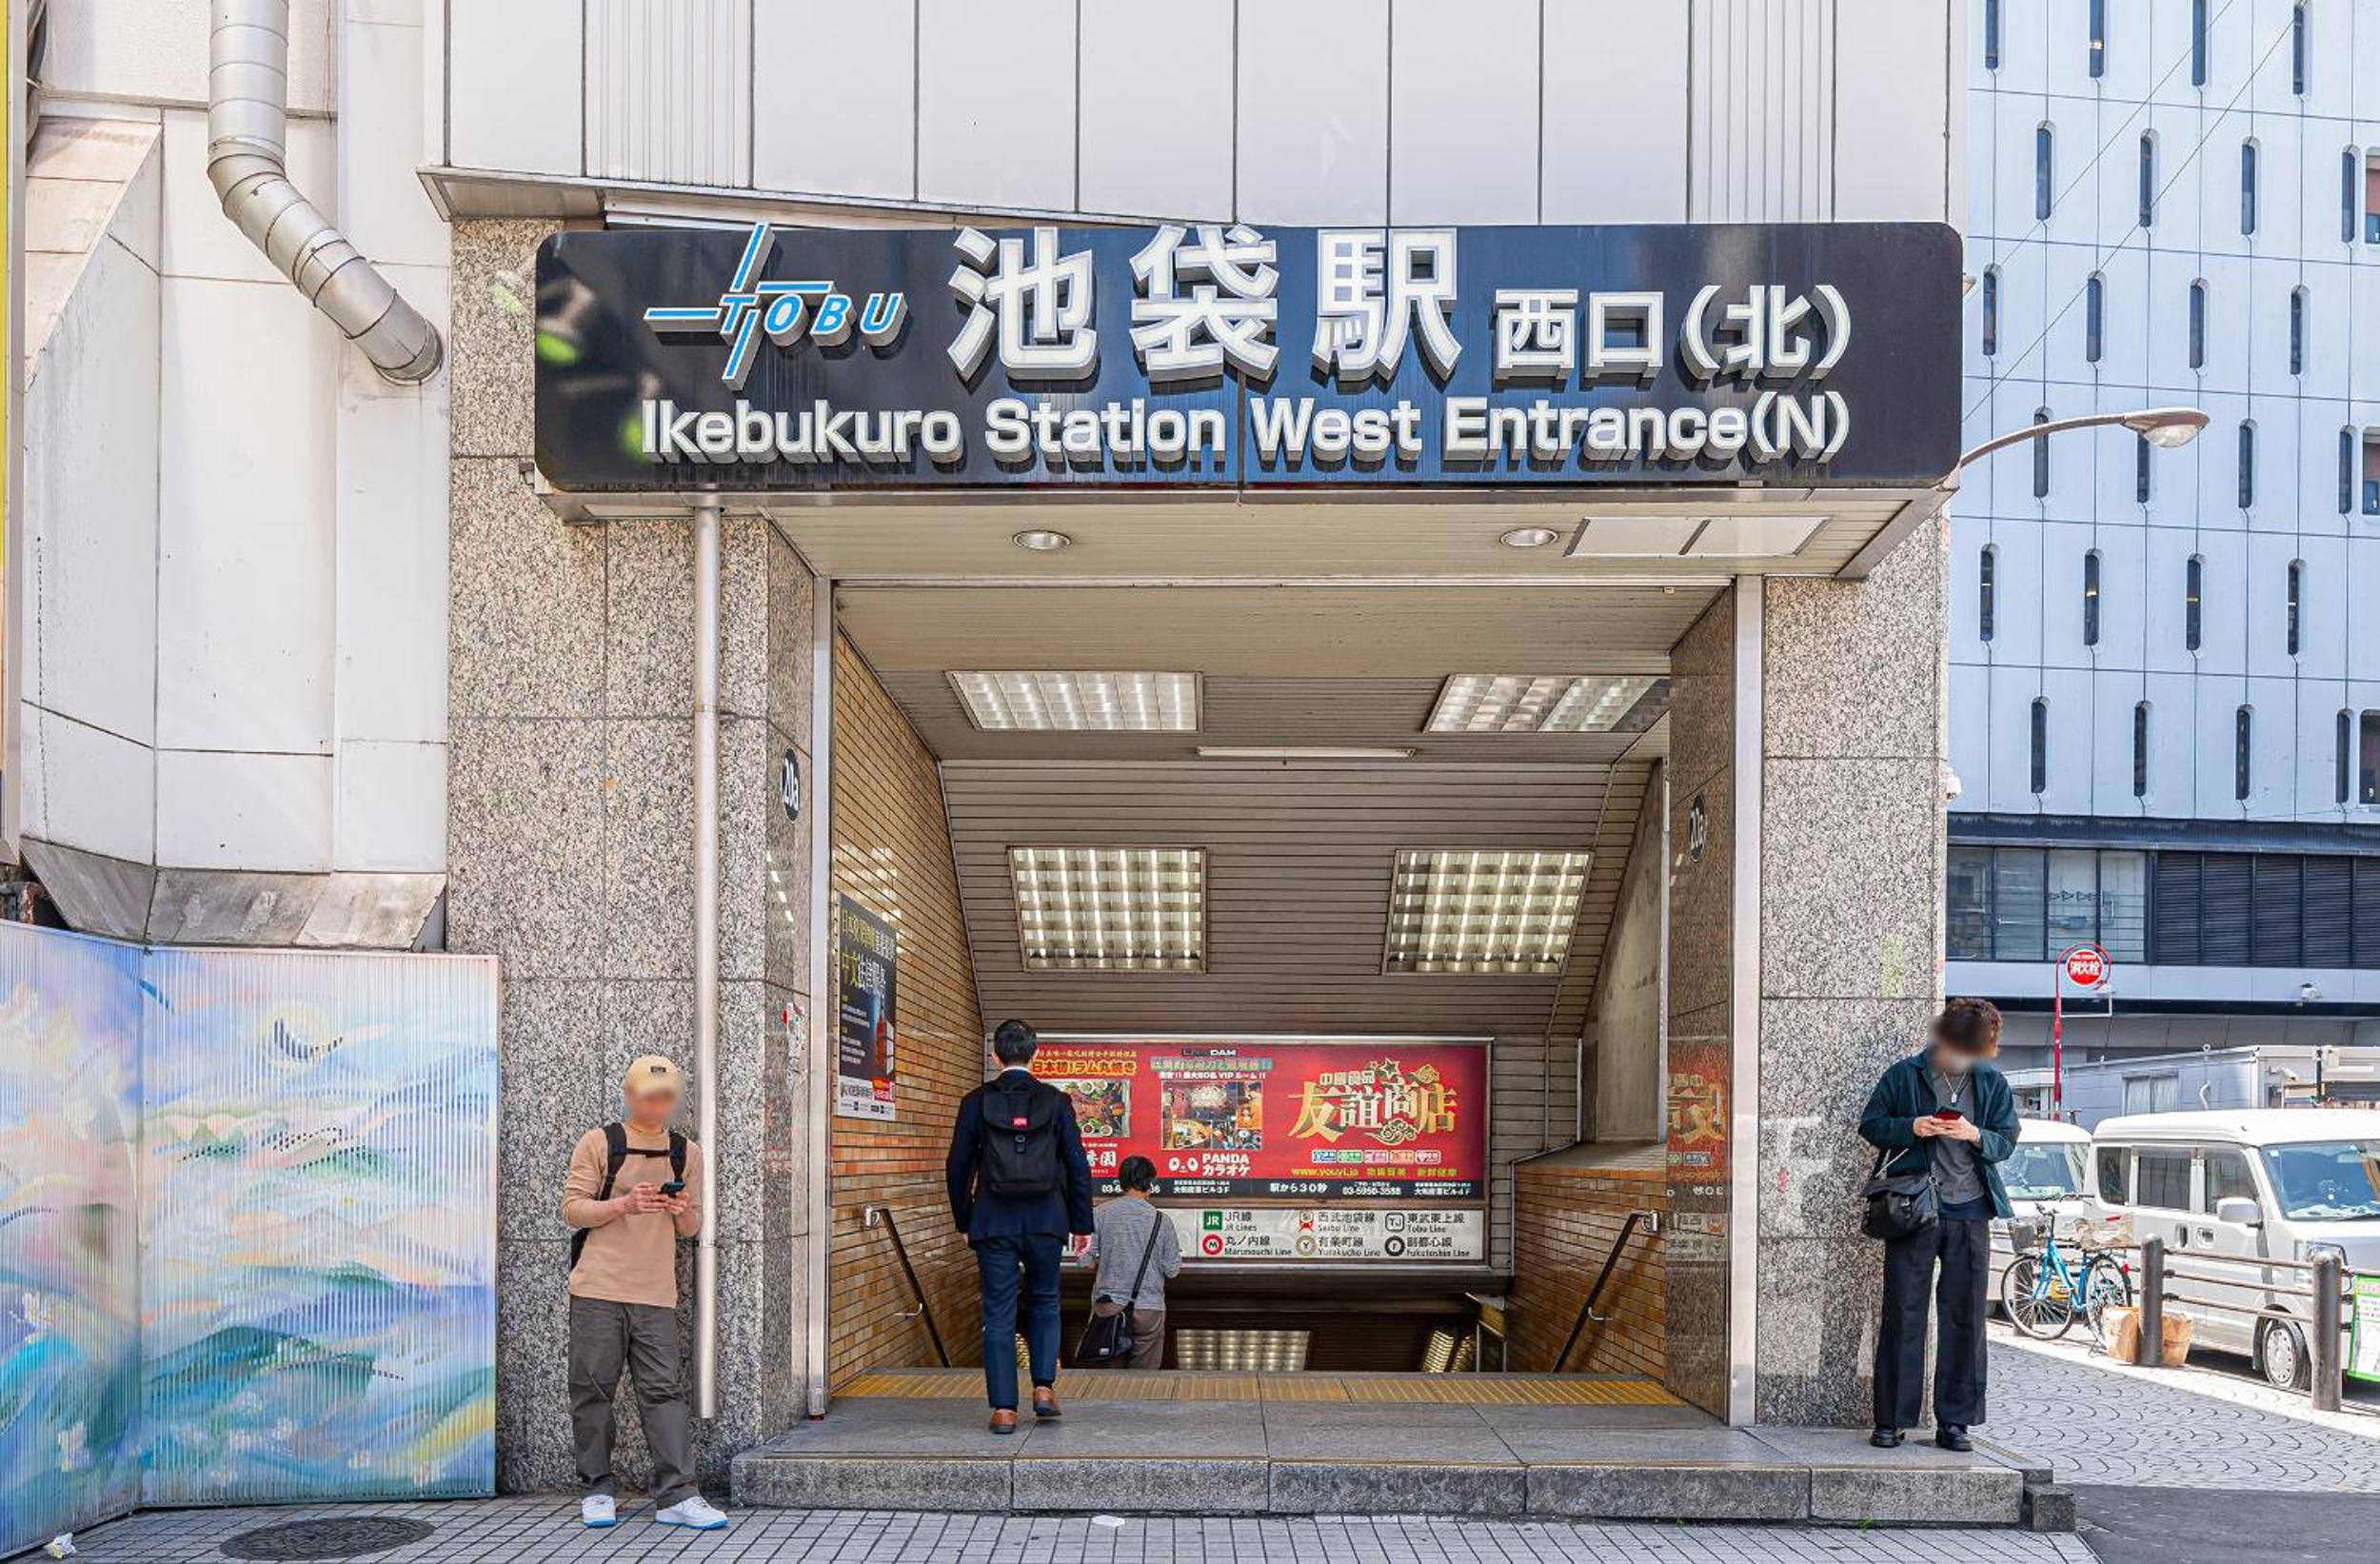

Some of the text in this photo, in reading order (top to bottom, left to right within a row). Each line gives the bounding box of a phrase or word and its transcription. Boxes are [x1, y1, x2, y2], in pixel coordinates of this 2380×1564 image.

[720, 292, 905, 339] TOBU
[641, 391, 1851, 463] Ikebukuro Station West Entrance(N)
[1287, 1077, 1457, 1141] 友誼商店
[1202, 1154, 1249, 1163] PANDA
[1202, 1163, 1250, 1176] カラオケ
[1224, 1212, 1253, 1222] JR線
[1225, 1236, 1270, 1246] 丸ノ内線
